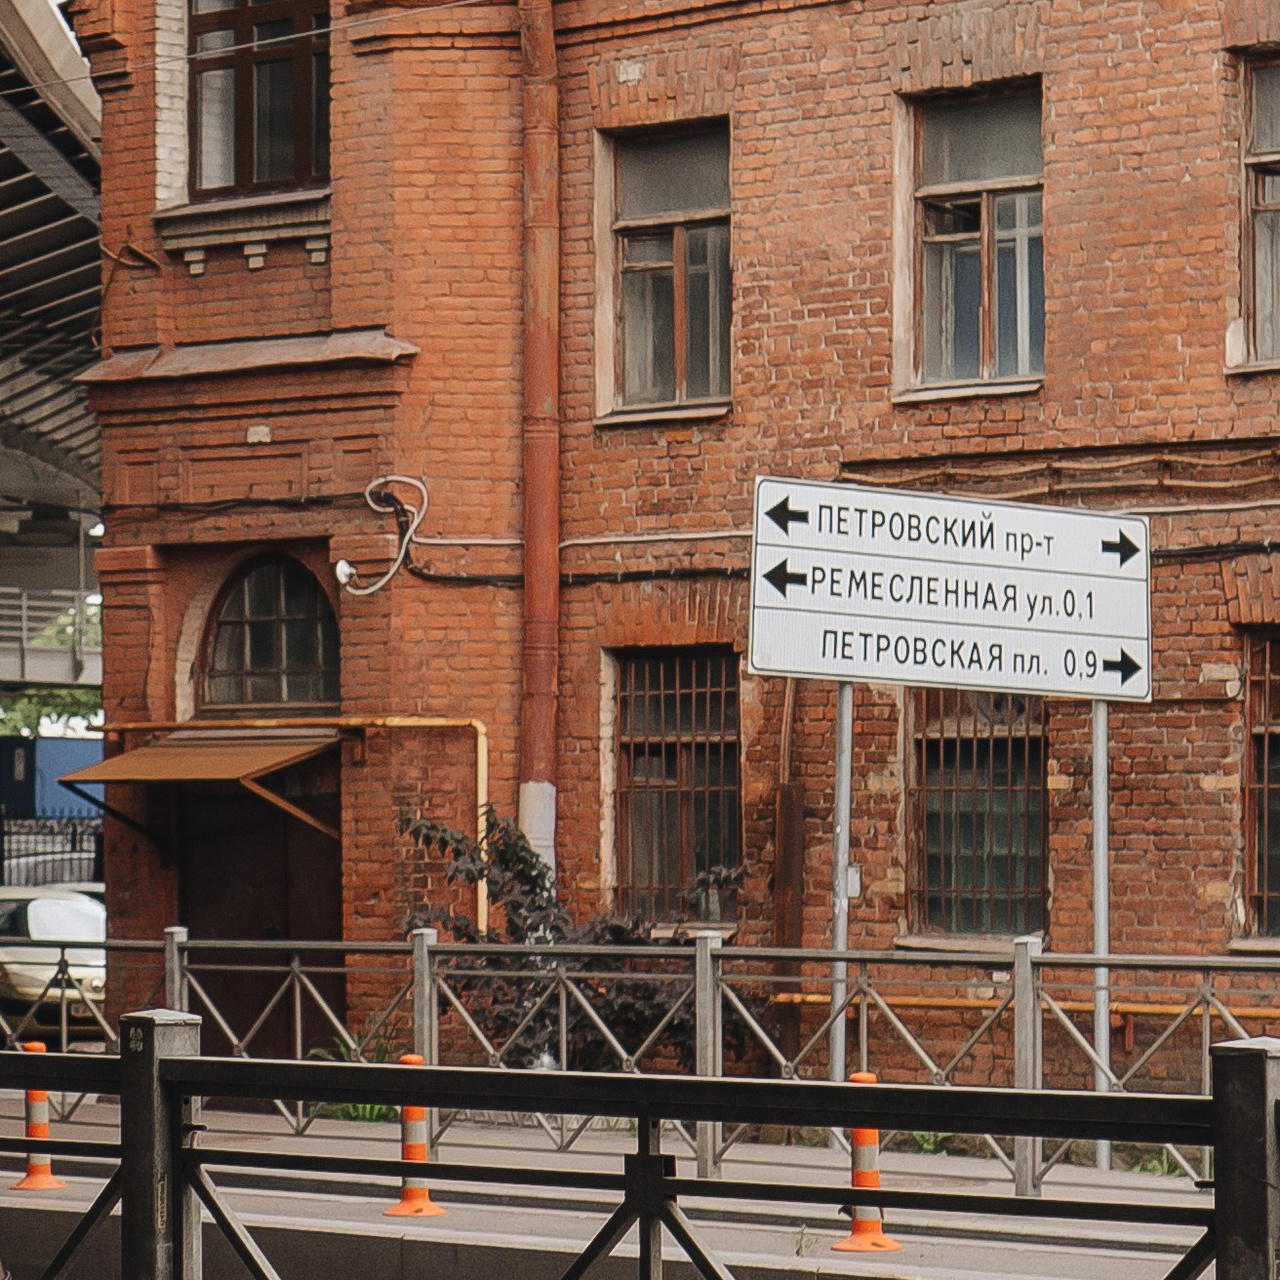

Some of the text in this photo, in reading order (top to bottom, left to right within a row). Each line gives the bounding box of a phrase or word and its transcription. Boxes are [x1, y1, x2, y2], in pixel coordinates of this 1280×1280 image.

[818, 504, 1055, 562] ПЕТРОВСКИЙ пр-т
[811, 566, 1017, 613] РЕМЕСЛЕННАЯ
[822, 629, 1097, 680] ПЕТРОВСКАЯ пл. 0,9
